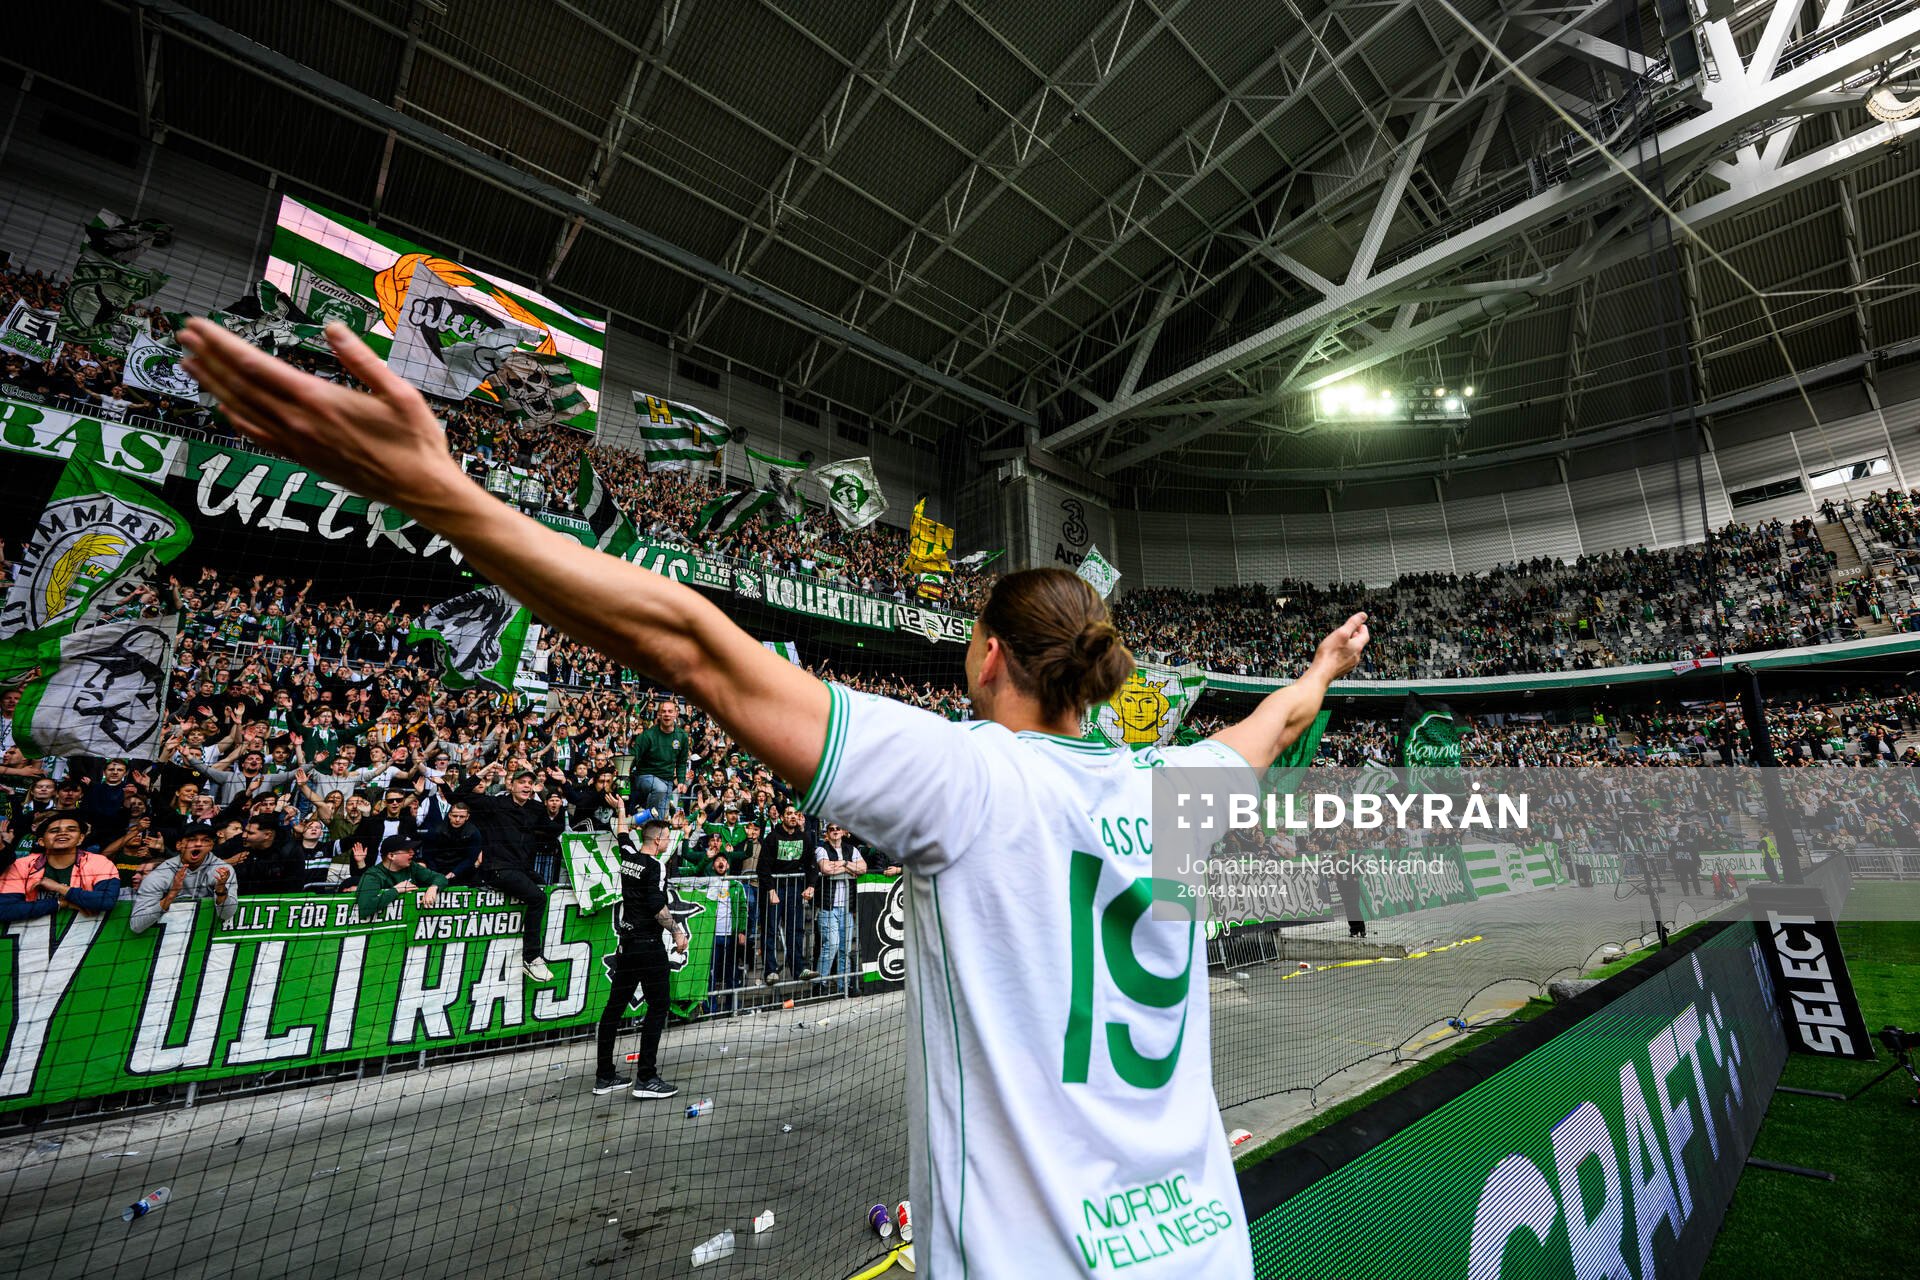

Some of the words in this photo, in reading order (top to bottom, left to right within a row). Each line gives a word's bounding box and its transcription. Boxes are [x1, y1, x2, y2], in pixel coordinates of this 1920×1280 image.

[1054, 542, 1086, 568] Are
[1838, 567, 1862, 577] B330
[695, 571, 731, 587] SOFIA
[765, 573, 893, 629] KOLLEKTIVET
[1091, 816, 1153, 856] ASC
[288, 902, 328, 929] FÖR
[416, 891, 472, 909] FIHET
[476, 889, 505, 908] FÖR
[414, 910, 525, 940] AVSTÄNGD
[1062, 849, 1197, 1091] 19
[1766, 910, 1855, 1055] SELECT
[1466, 1001, 1721, 1280] CRAFT
[1082, 1174, 1193, 1231] NORDIC
[1076, 1199, 1232, 1270] WELLNESS
